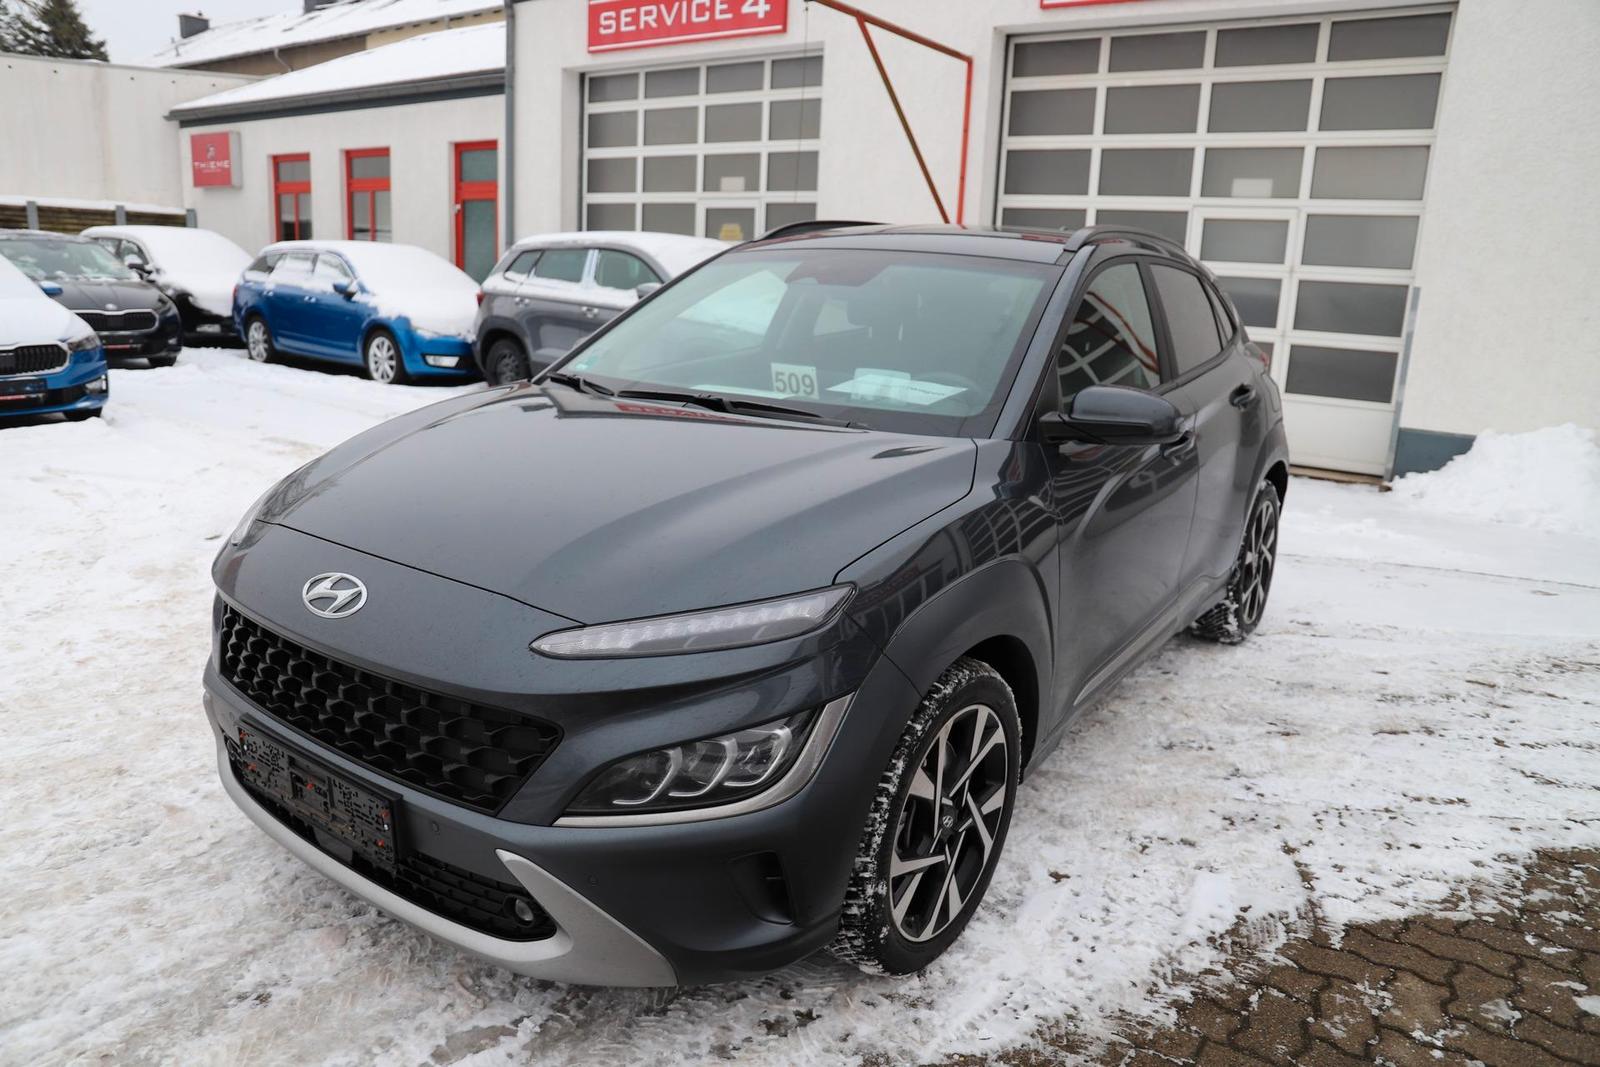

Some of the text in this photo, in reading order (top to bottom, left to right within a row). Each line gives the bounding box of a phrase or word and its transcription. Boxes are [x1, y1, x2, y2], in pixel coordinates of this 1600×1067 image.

[599, 0, 770, 34] SERVICE 4
[775, 371, 815, 396] 509
